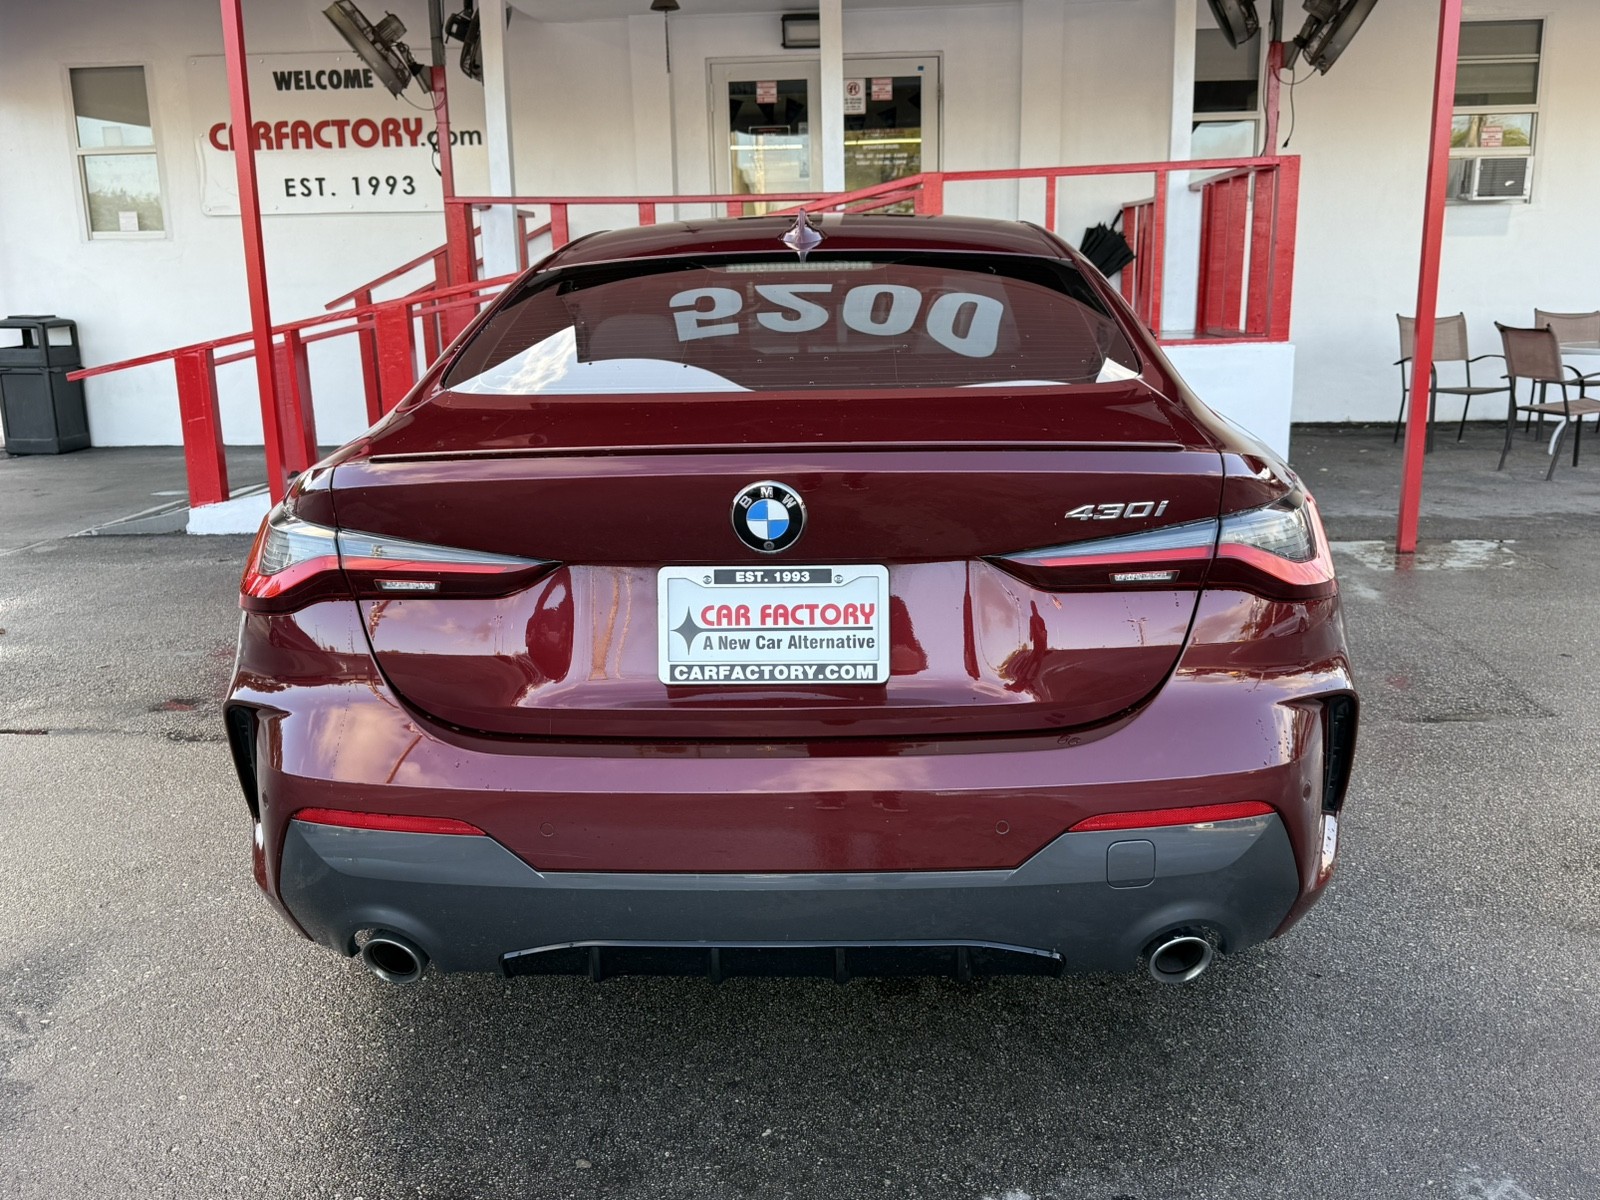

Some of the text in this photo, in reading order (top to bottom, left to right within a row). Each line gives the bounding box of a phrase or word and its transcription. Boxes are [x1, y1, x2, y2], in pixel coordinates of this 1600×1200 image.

[273, 68, 374, 91] WELCOME
[209, 117, 482, 151] CRFACTORY.com
[285, 175, 416, 197] EST. 1993
[739, 486, 797, 509] BMW
[1064, 500, 1169, 520] 430i
[735, 571, 811, 583] EST. 1993
[700, 603, 875, 627] CAR FACTORY
[703, 634, 875, 651] A New Car Alternative
[673, 664, 875, 680] CARFACTORY.COM
